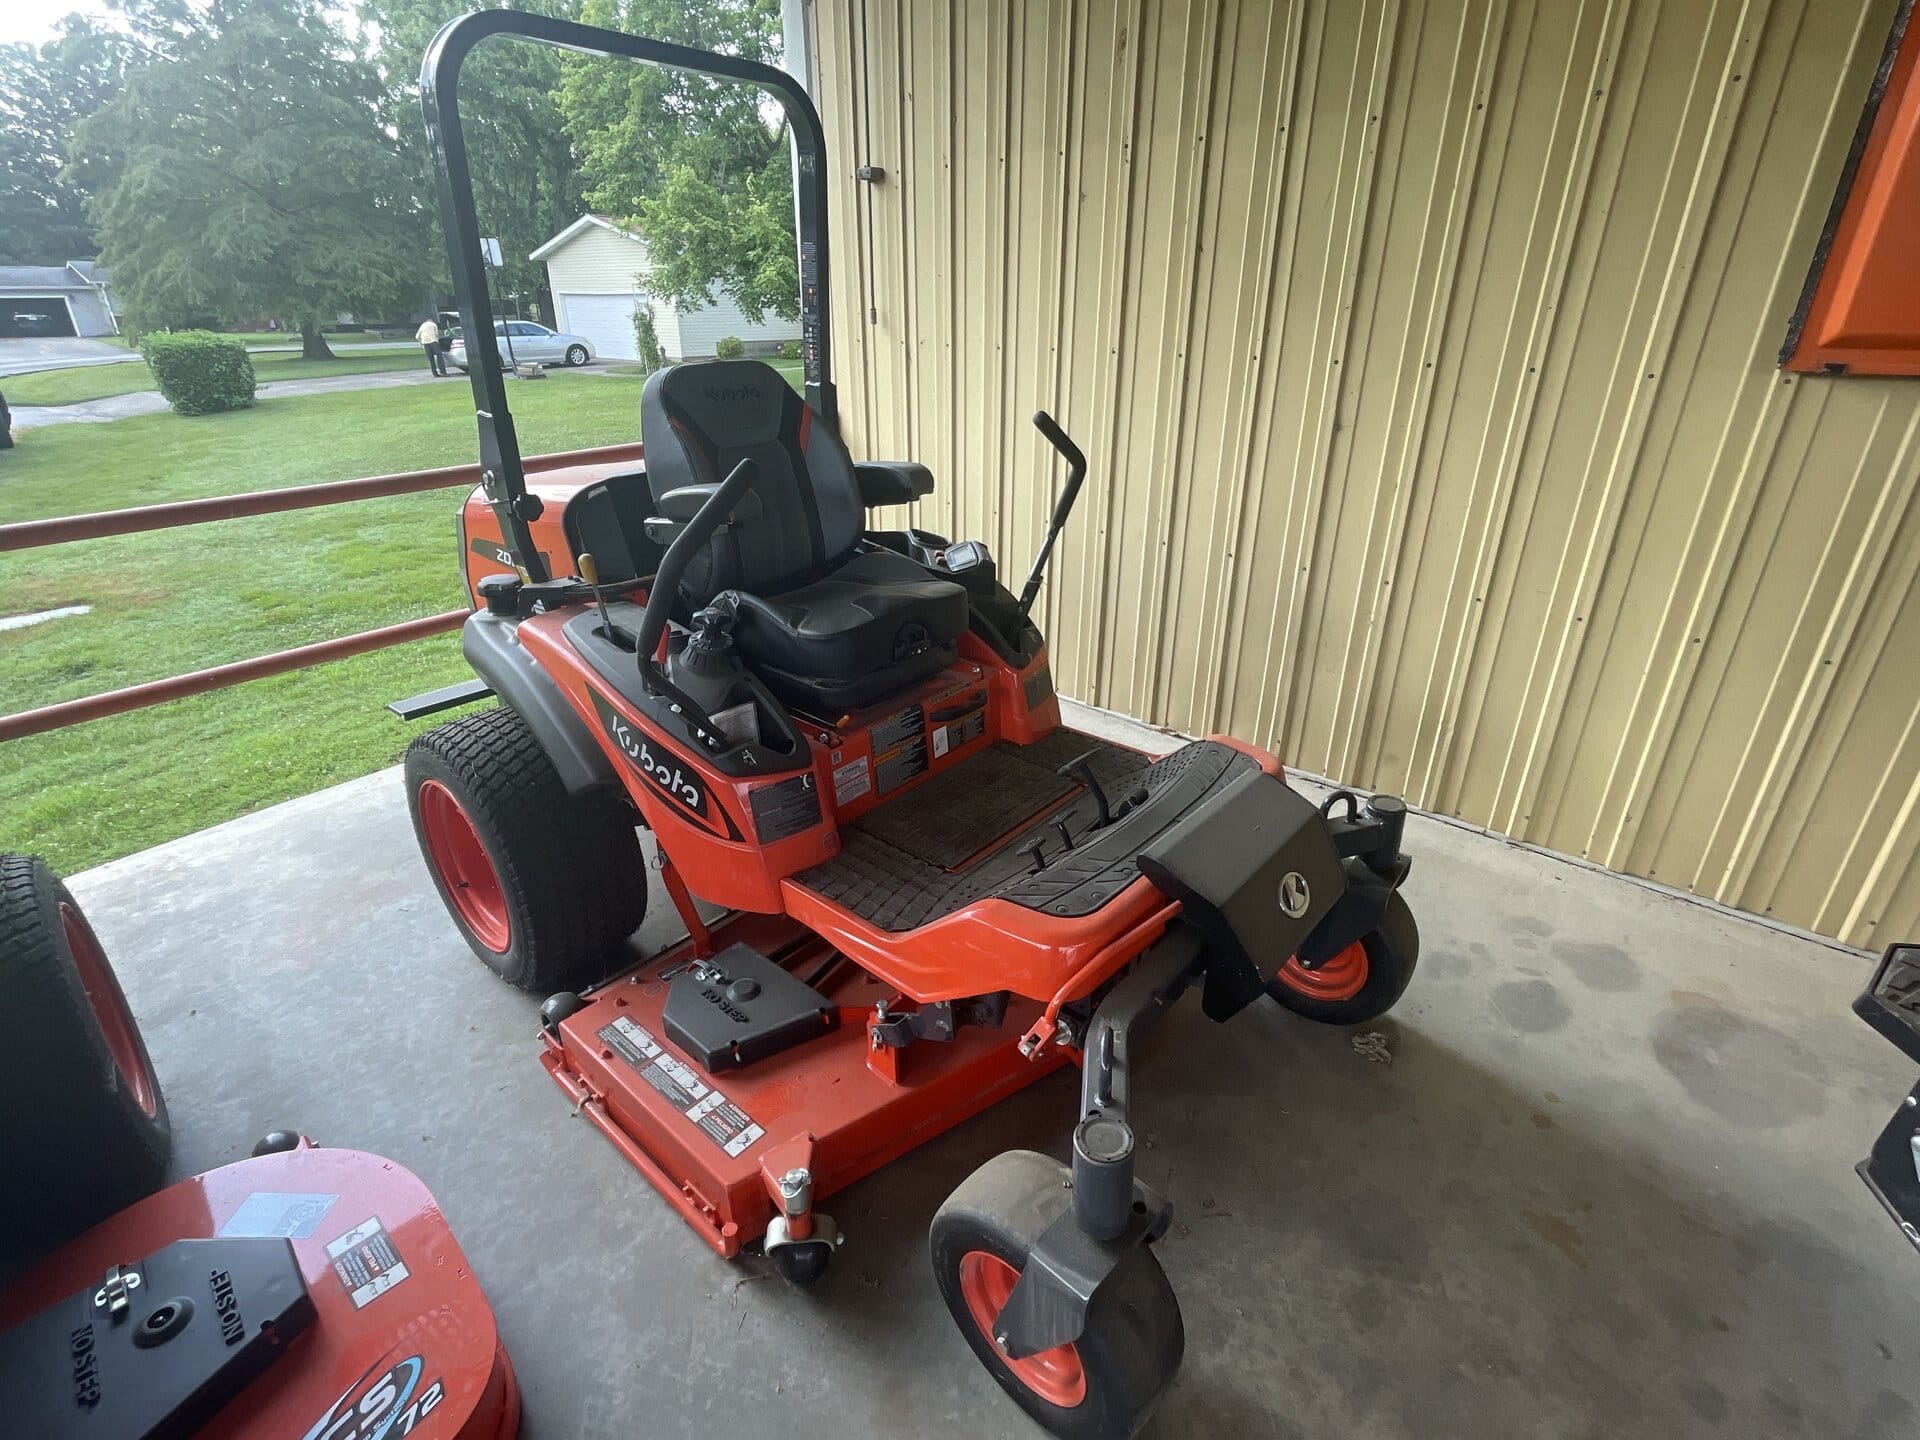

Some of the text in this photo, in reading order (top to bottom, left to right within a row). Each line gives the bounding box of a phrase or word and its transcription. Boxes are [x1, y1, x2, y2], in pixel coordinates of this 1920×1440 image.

[703, 384, 760, 402] Kubota
[496, 548, 515, 567] ZD
[612, 715, 699, 808] Kubota
[701, 989, 750, 1023] NO STEP
[220, 1309, 245, 1347] NO
[72, 1323, 101, 1409] NO STEP
[397, 1383, 443, 1436] 72
